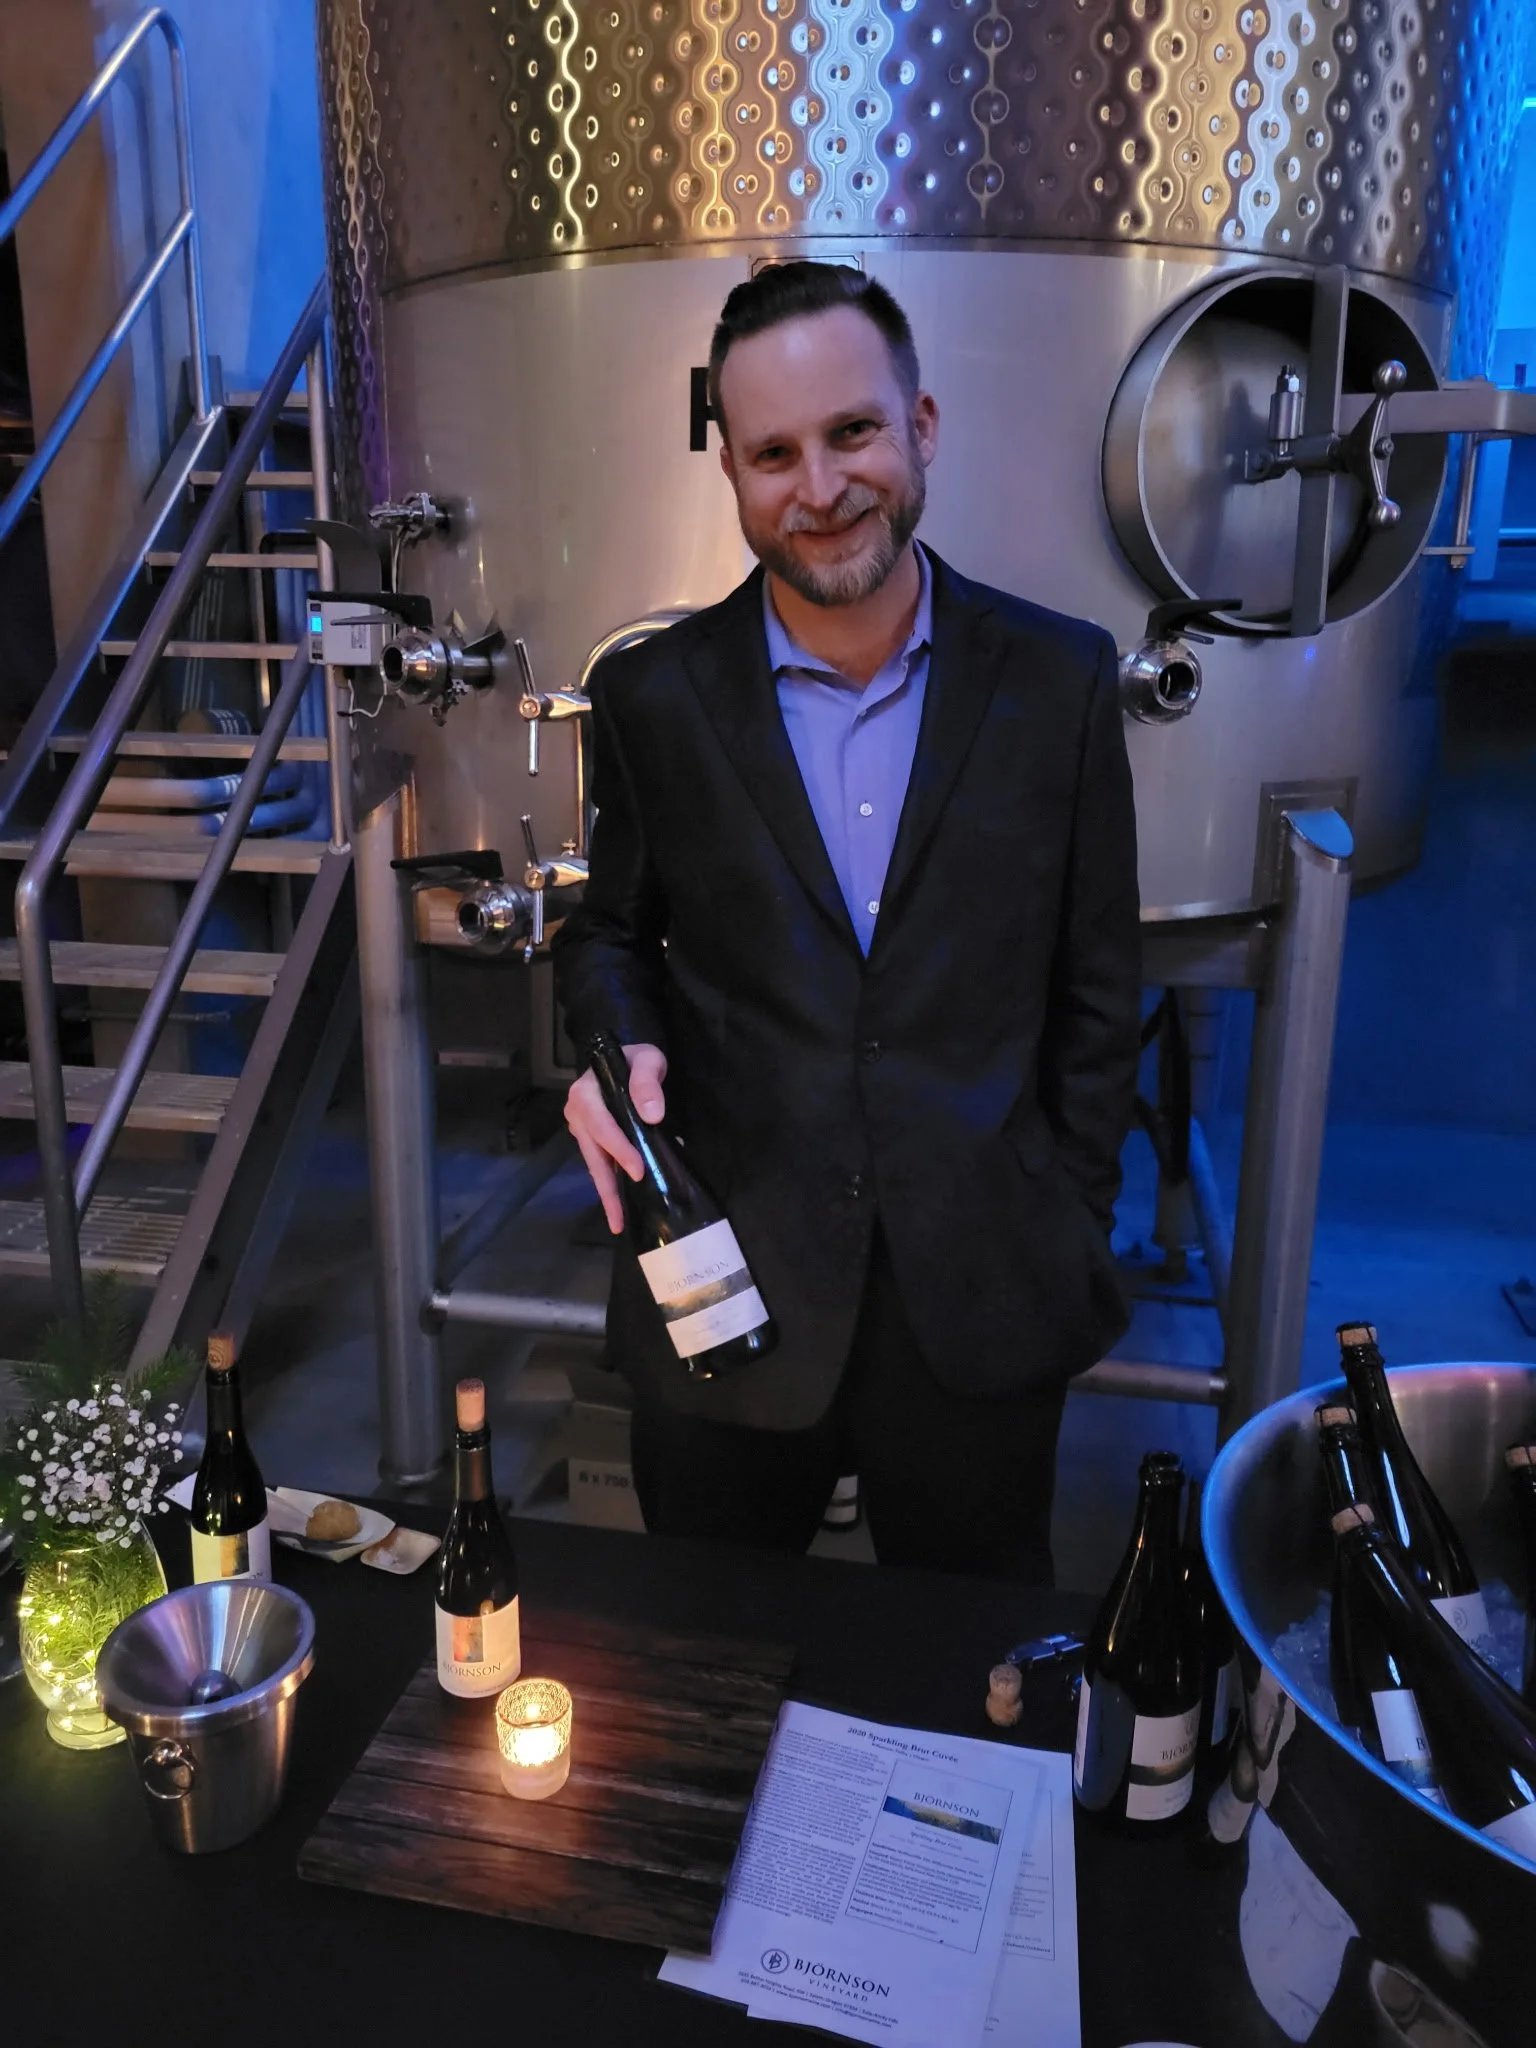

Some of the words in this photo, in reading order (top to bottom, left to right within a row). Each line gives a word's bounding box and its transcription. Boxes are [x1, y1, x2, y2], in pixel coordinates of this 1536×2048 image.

[847, 1726, 867, 1737] 2020
[868, 1732, 909, 1750] Sparkling
[911, 1743, 931, 1756] Brut
[912, 1790, 981, 1820] BJORNSON
[793, 1957, 891, 1998] BJÖRNSON
[809, 1979, 869, 2003] VINEYARD
